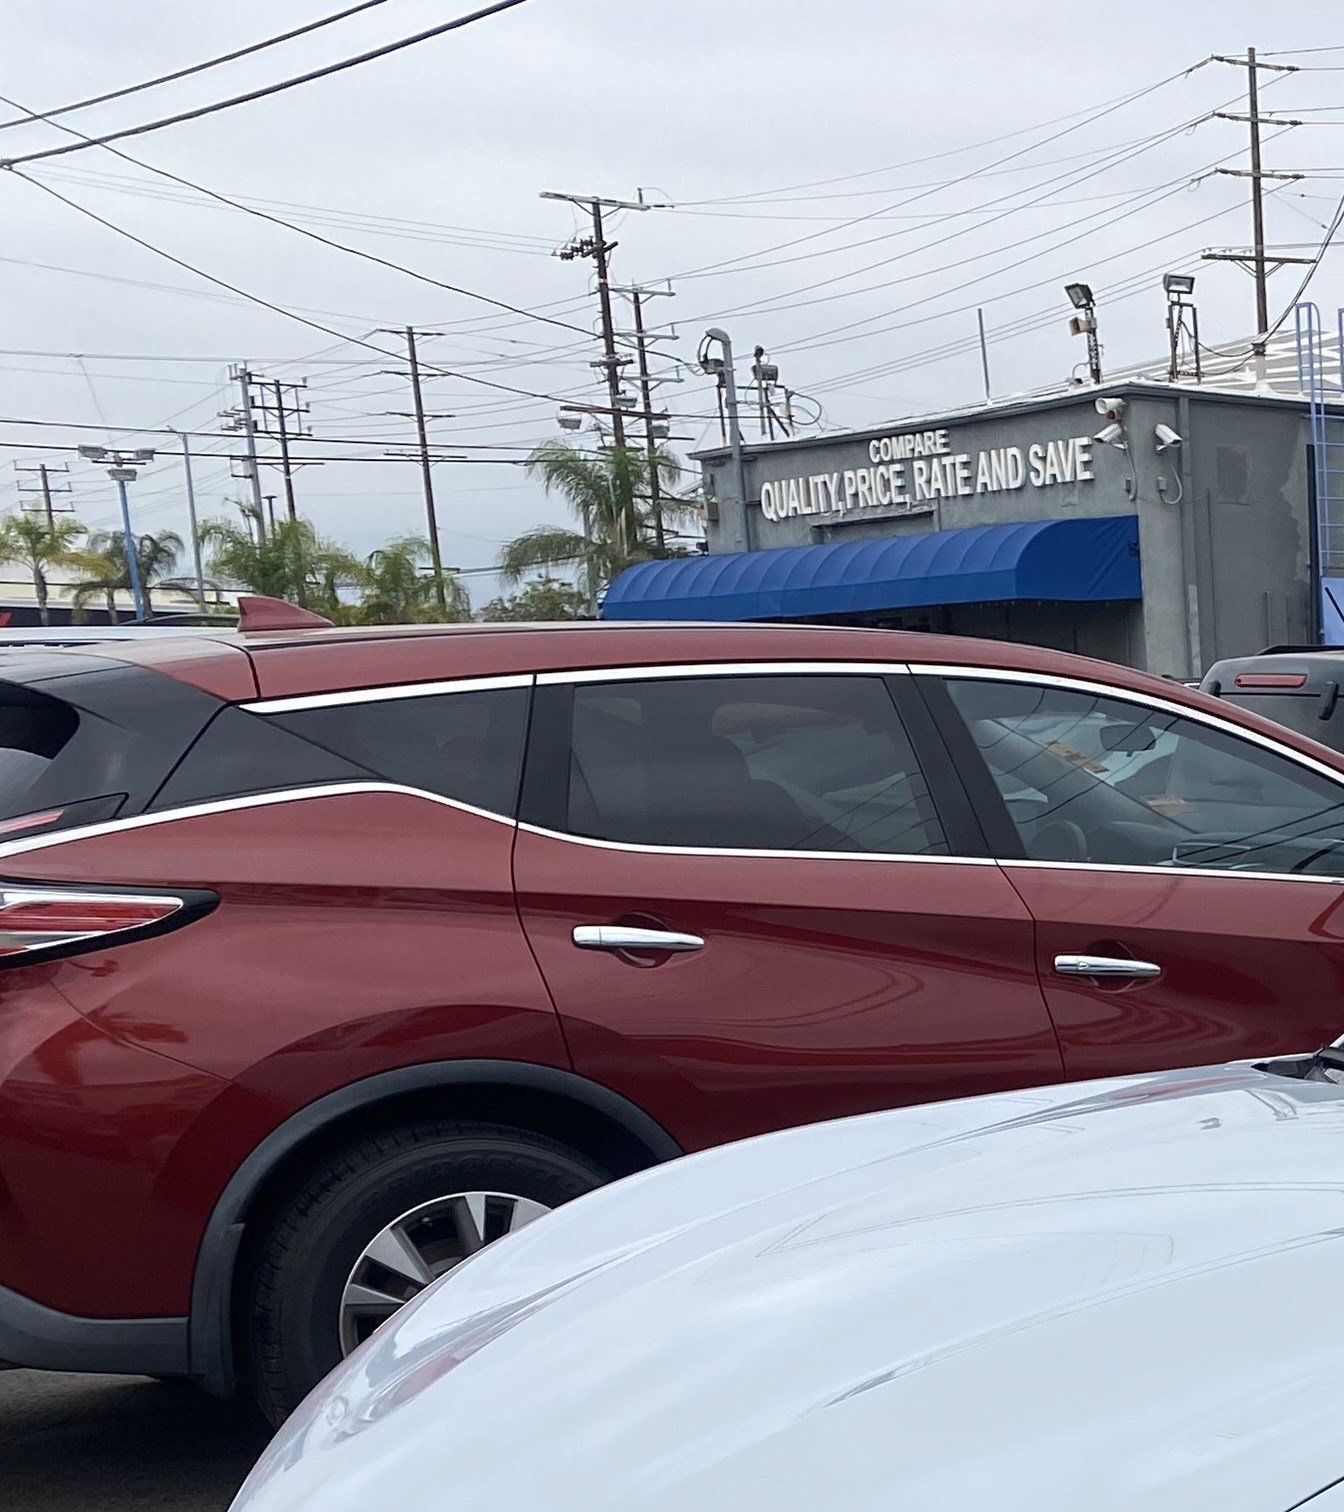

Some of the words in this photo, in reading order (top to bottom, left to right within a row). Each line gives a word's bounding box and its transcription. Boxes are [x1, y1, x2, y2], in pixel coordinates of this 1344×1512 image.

[869, 429, 950, 463] COMPARE
[913, 453, 974, 500] RATE
[976, 446, 1027, 493] AND
[1029, 436, 1096, 487] SAVE
